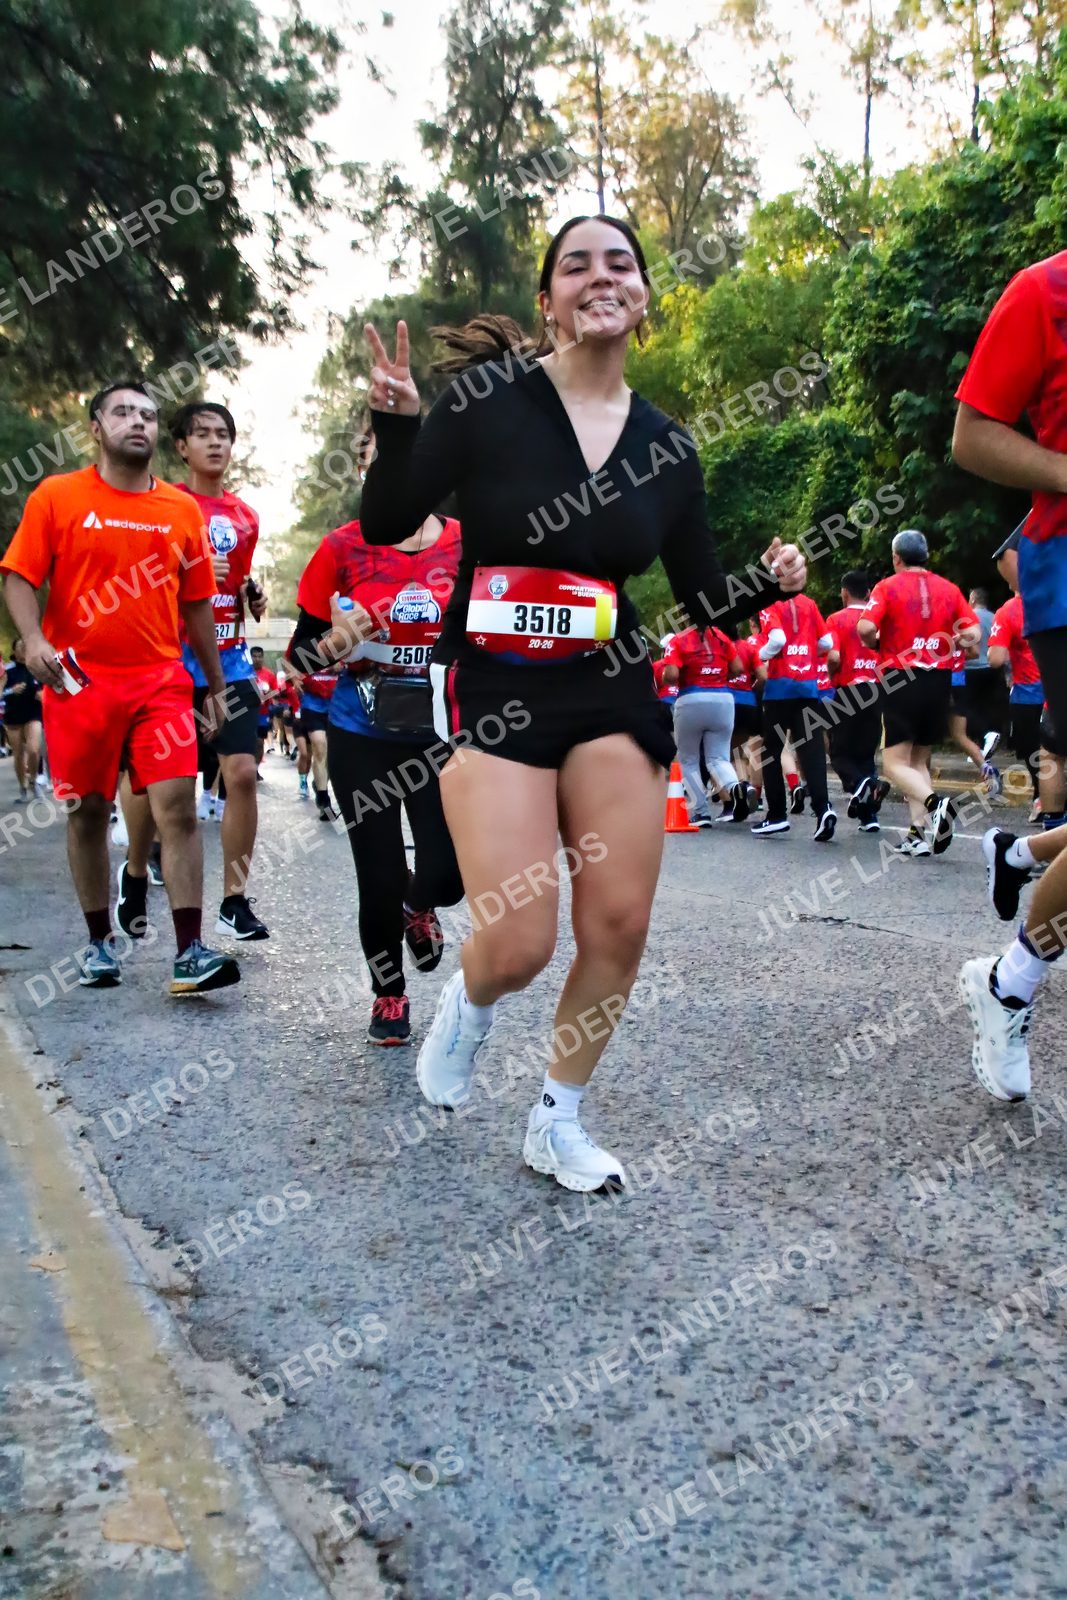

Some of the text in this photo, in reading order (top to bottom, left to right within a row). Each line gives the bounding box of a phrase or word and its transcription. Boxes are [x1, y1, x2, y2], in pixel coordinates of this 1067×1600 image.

[105, 519, 168, 533] asdeporte
[401, 594, 428, 602] BIMBO
[402, 604, 428, 613] Global
[398, 612, 419, 620] Race
[513, 604, 571, 635] 3518
